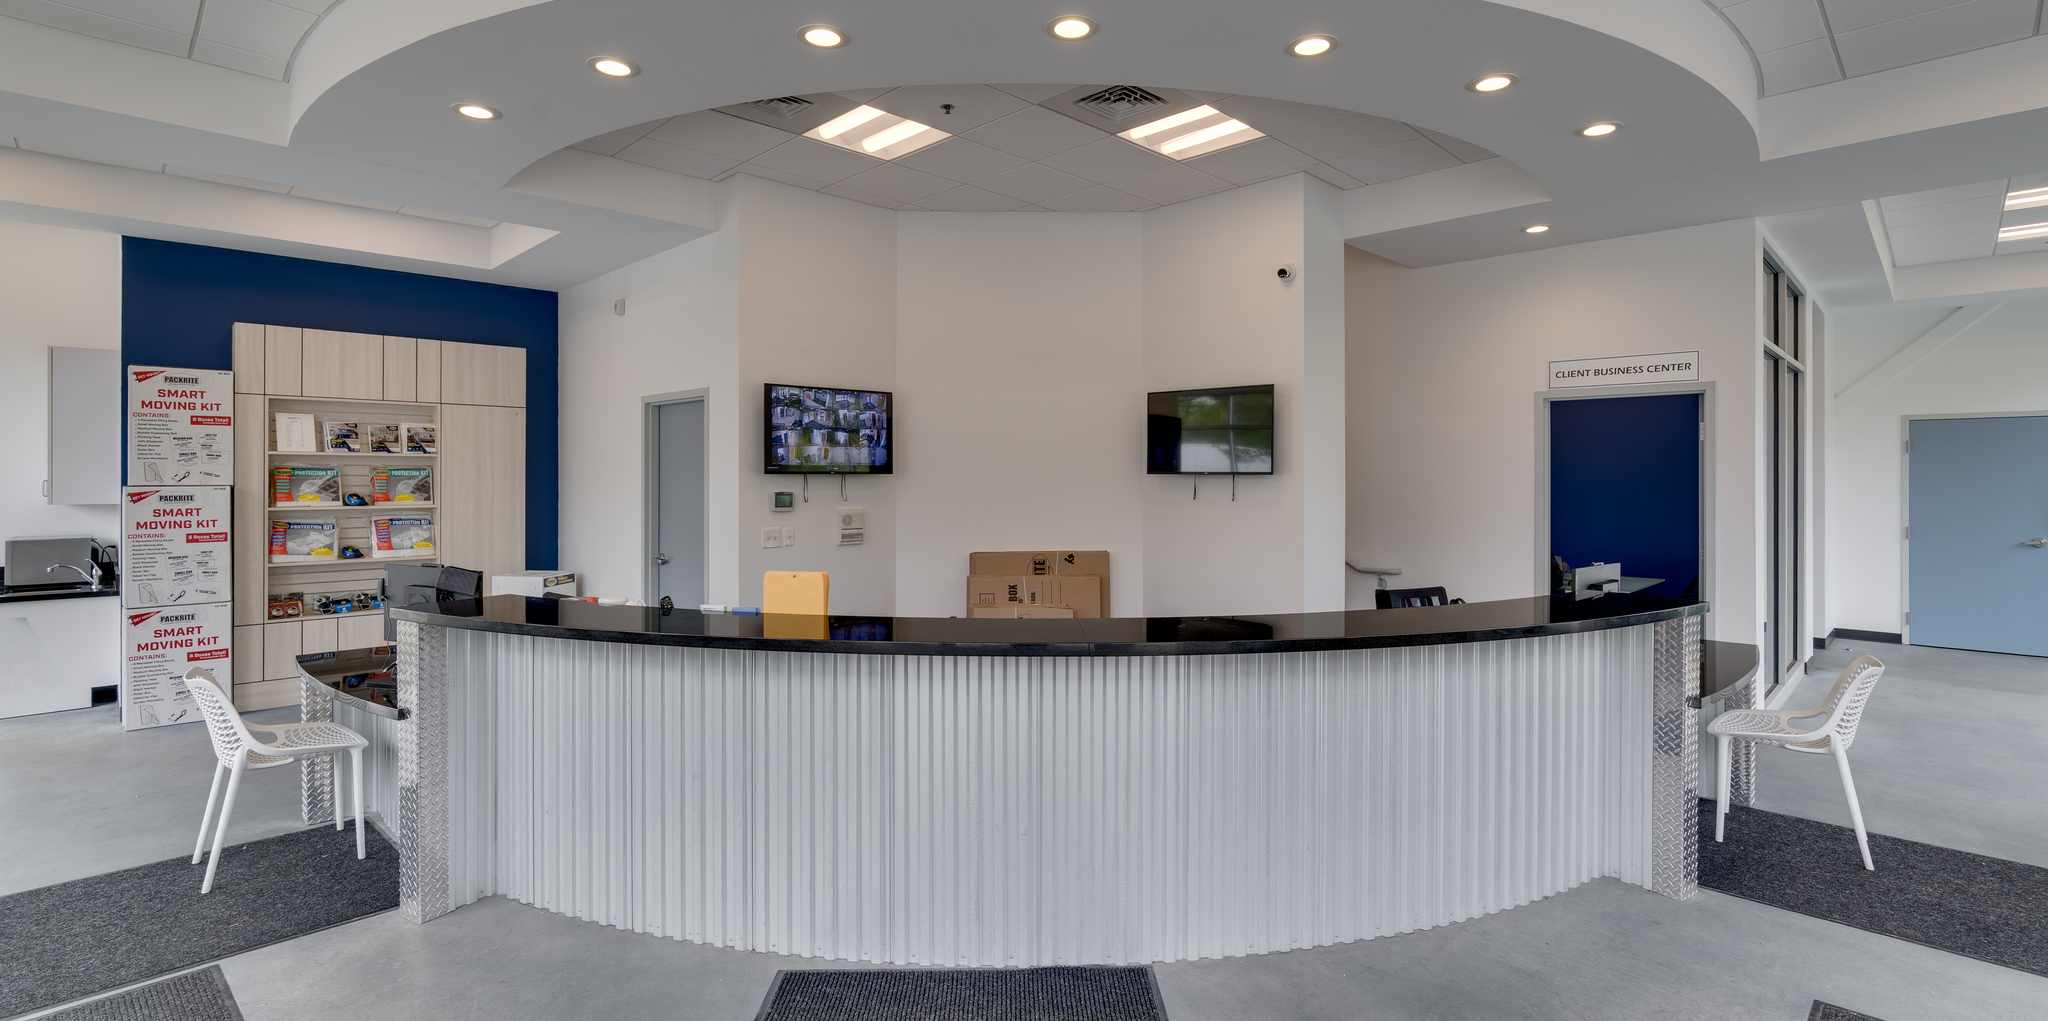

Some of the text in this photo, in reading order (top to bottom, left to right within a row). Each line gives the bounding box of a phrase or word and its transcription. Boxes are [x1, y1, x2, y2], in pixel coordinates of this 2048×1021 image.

[1555, 362, 1692, 379] CLIENT BUSINESS CENTER
[164, 376, 199, 384] PACKRITE
[157, 389, 206, 399] SMART
[141, 400, 222, 412] MOVING KIT
[153, 508, 202, 517] SMART
[136, 520, 218, 530] MOVING KIT
[1008, 584, 1018, 602] BOX
[160, 613, 195, 623] PACKRITE
[153, 626, 204, 638] SMART
[137, 636, 220, 652] MOVING KIT
